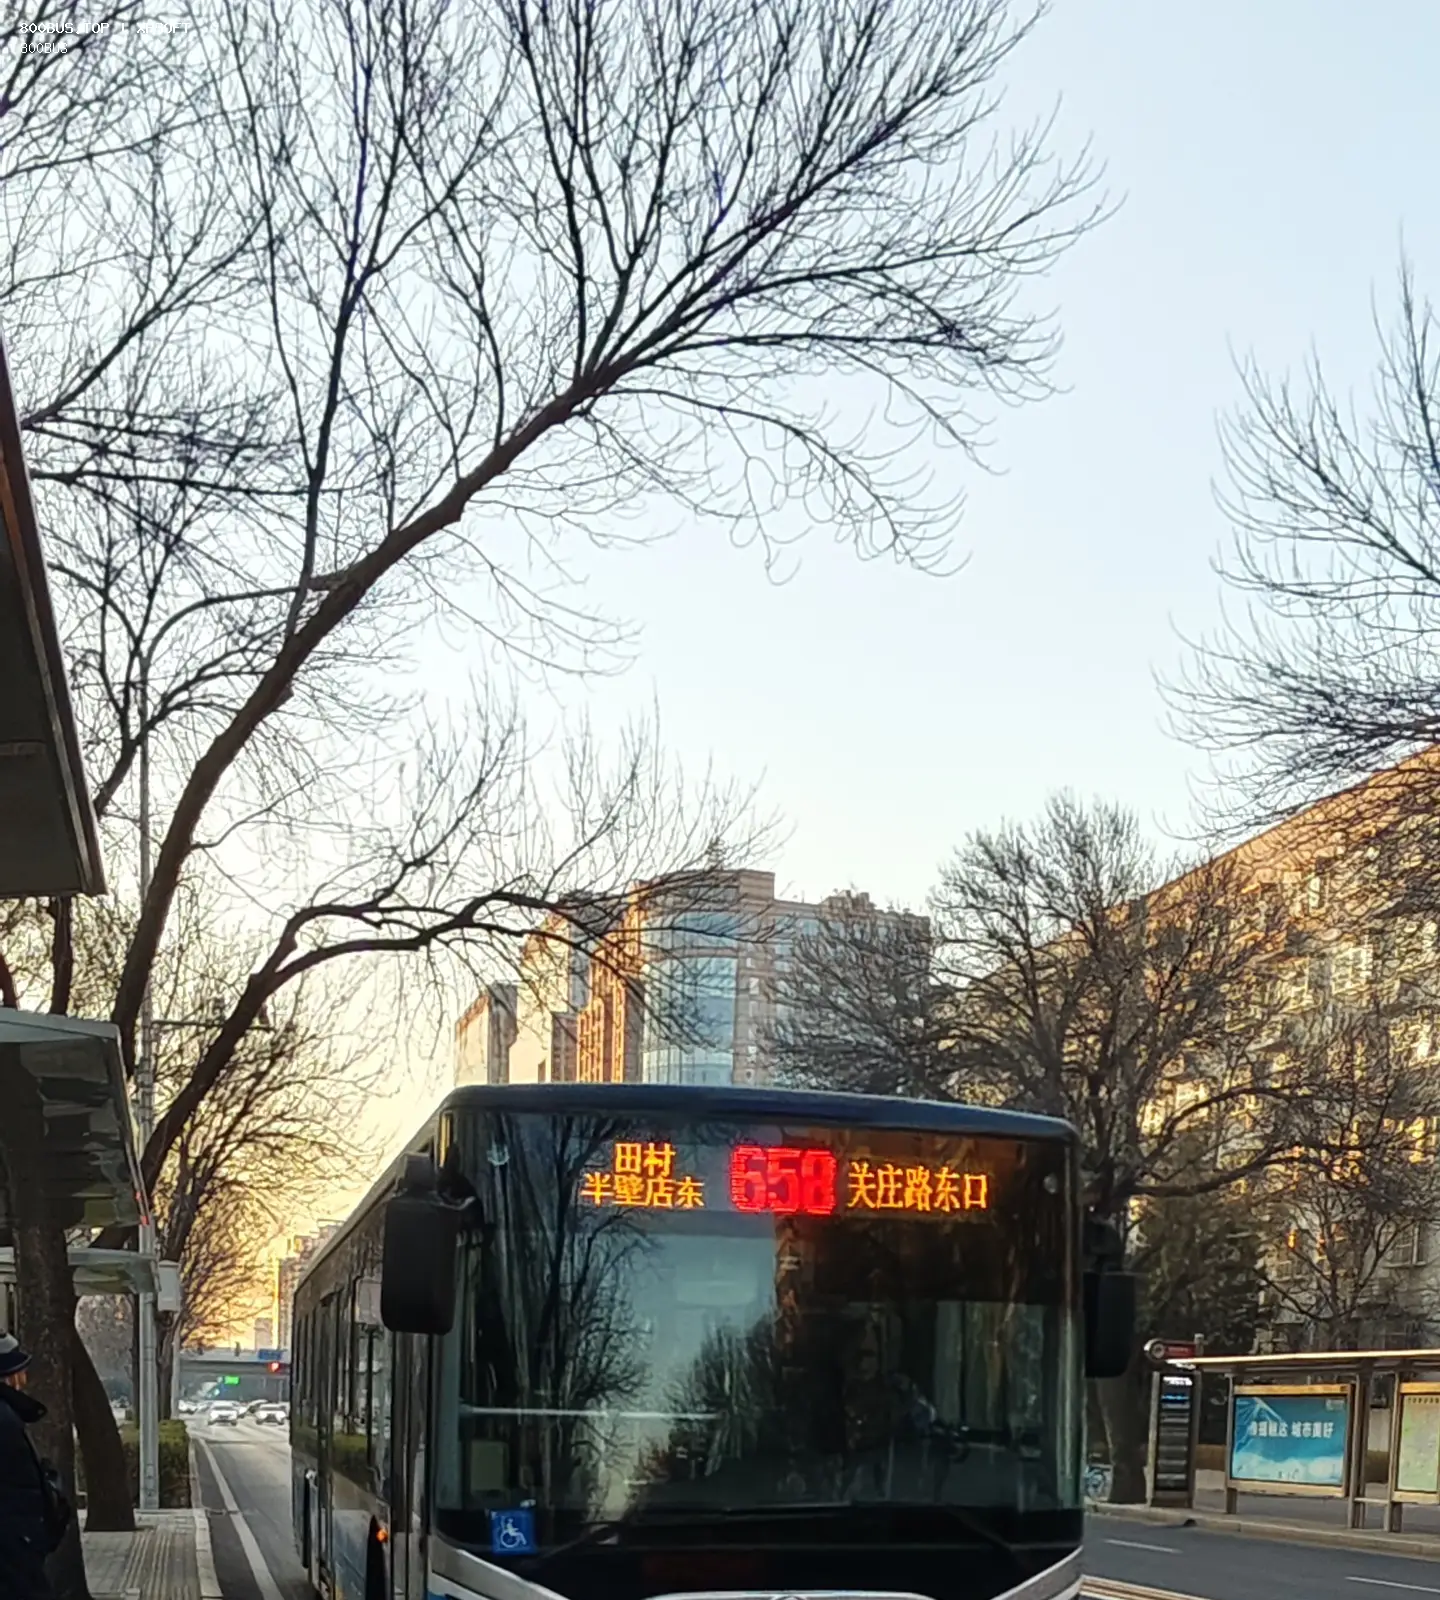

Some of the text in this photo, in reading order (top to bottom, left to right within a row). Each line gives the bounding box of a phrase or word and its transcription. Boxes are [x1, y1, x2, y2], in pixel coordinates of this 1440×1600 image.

[614, 1143, 676, 1177] 田村
[730, 1145, 838, 1214] 658
[581, 1174, 704, 1208] 半壁店东
[847, 1162, 988, 1211] 关庄路东口
